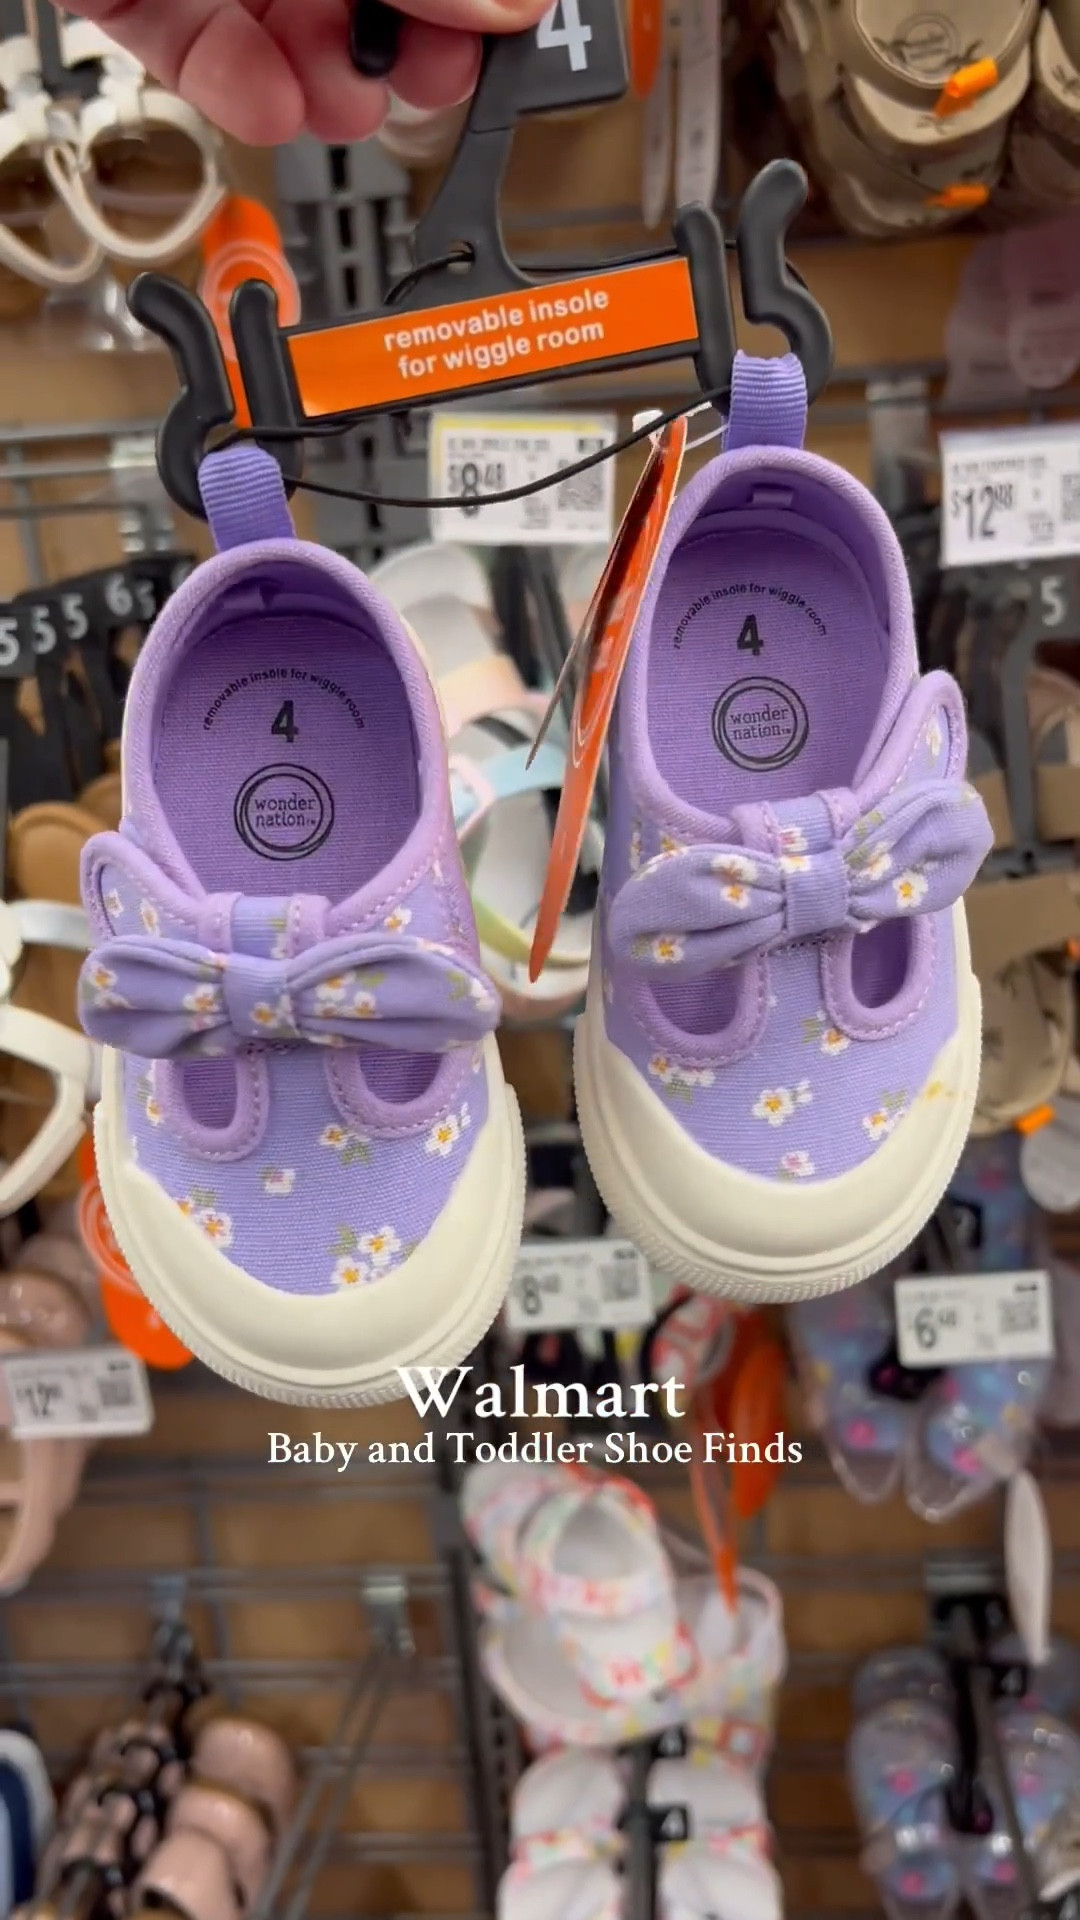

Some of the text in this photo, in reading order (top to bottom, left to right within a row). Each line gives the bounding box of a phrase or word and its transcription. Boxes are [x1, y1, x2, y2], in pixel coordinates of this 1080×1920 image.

[537, 0, 592, 71] 4
[383, 288, 609, 351] removable insole
[398, 322, 605, 379] for wiggle room
[61, 593, 88, 640] 5
[105, 574, 133, 617] 6
[674, 583, 827, 650] removable insole for wiggle room
[1041, 576, 1065, 626] 5
[0, 617, 20, 666] 5
[31, 605, 57, 654] 5
[737, 614, 764, 656] 4
[203, 667, 365, 731] removable insole for wiggle room
[271, 700, 299, 743] 4
[730, 703, 789, 724] wonder
[255, 793, 316, 811] wonder
[661, 1806, 684, 1838] 4
